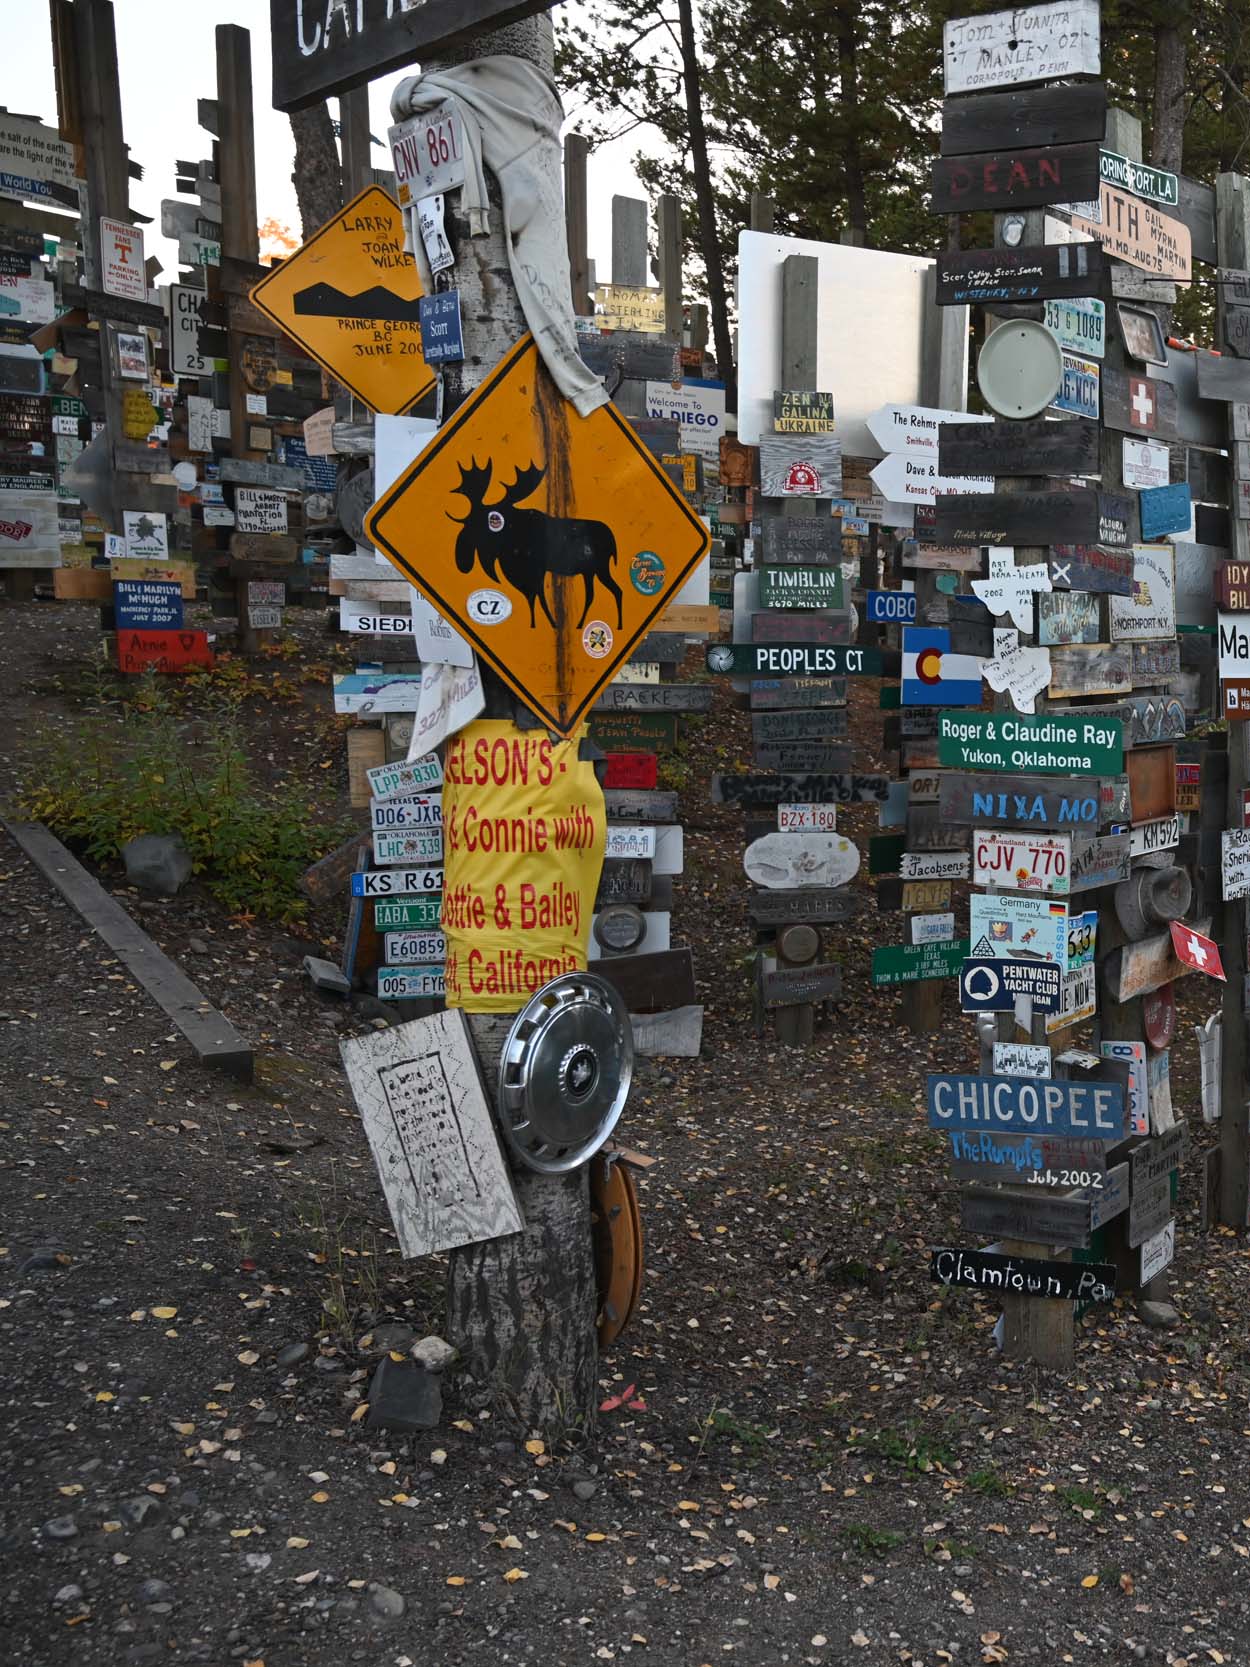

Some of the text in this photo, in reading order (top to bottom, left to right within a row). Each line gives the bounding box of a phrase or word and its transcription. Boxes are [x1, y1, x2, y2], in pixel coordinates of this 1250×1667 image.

[953, 20, 996, 46] Tom
[426, 118, 457, 168] 861
[26, 149, 43, 163] light
[4, 175, 32, 190] World
[951, 158, 1061, 195] DEAN
[1158, 177, 1172, 198] LA
[341, 216, 393, 232] LARRY
[1145, 209, 1163, 229] GAIL
[362, 241, 399, 253] JOAN
[1150, 227, 1177, 251] MYRNA
[1152, 256, 1163, 272] 75
[1157, 244, 1187, 271] MARTIN
[109, 263, 139, 276] PARKING
[115, 272, 133, 282] ONLY
[337, 319, 377, 331] PRINCE
[1077, 311, 1101, 341] 1089
[353, 343, 393, 357] JUNE
[186, 355, 205, 369] 25
[649, 397, 688, 409] Welcome
[783, 393, 810, 405] ZEN
[671, 412, 719, 426] DIEGO
[782, 407, 828, 418] GALINA
[893, 412, 937, 429] The Rehms
[780, 419, 834, 432] UKRAINE
[906, 462, 925, 476] Dave
[905, 484, 928, 495] Kansas
[768, 570, 836, 588] TIMBLIN
[118, 583, 181, 595] BILL MARILYN
[477, 600, 501, 616] CZ
[1117, 617, 1156, 631] NORTHPORT
[756, 648, 864, 672] PEOPLES CT
[942, 719, 1116, 748] Roger & Claudine Ray
[961, 748, 1092, 768] Yukon, Oklahoma
[415, 764, 440, 782] 830
[973, 793, 1097, 823] NIXA MO
[389, 831, 431, 839] OKLAHOMA
[463, 804, 593, 854] Connie with
[1143, 819, 1178, 849] KM 592
[419, 838, 441, 855] 339
[979, 837, 1026, 847] Newfoundland
[977, 845, 1014, 872] CJV
[1029, 848, 1066, 876] 770
[908, 861, 964, 877] Jacobsens
[365, 873, 417, 893] KS R
[494, 881, 580, 936] & Bailey
[1000, 897, 1041, 911] Germany
[384, 909, 410, 924] ABA
[940, 942, 960, 950] VILLAGE
[1002, 965, 1059, 984] PENTWATER
[384, 978, 406, 992] 005
[1003, 979, 1058, 995] YACHT CLUB
[933, 1080, 1115, 1130] CHICOPEE
[951, 1134, 979, 1159] The
[1027, 1169, 1104, 1189] July 2002
[936, 1252, 1072, 1299] Clamtown,
